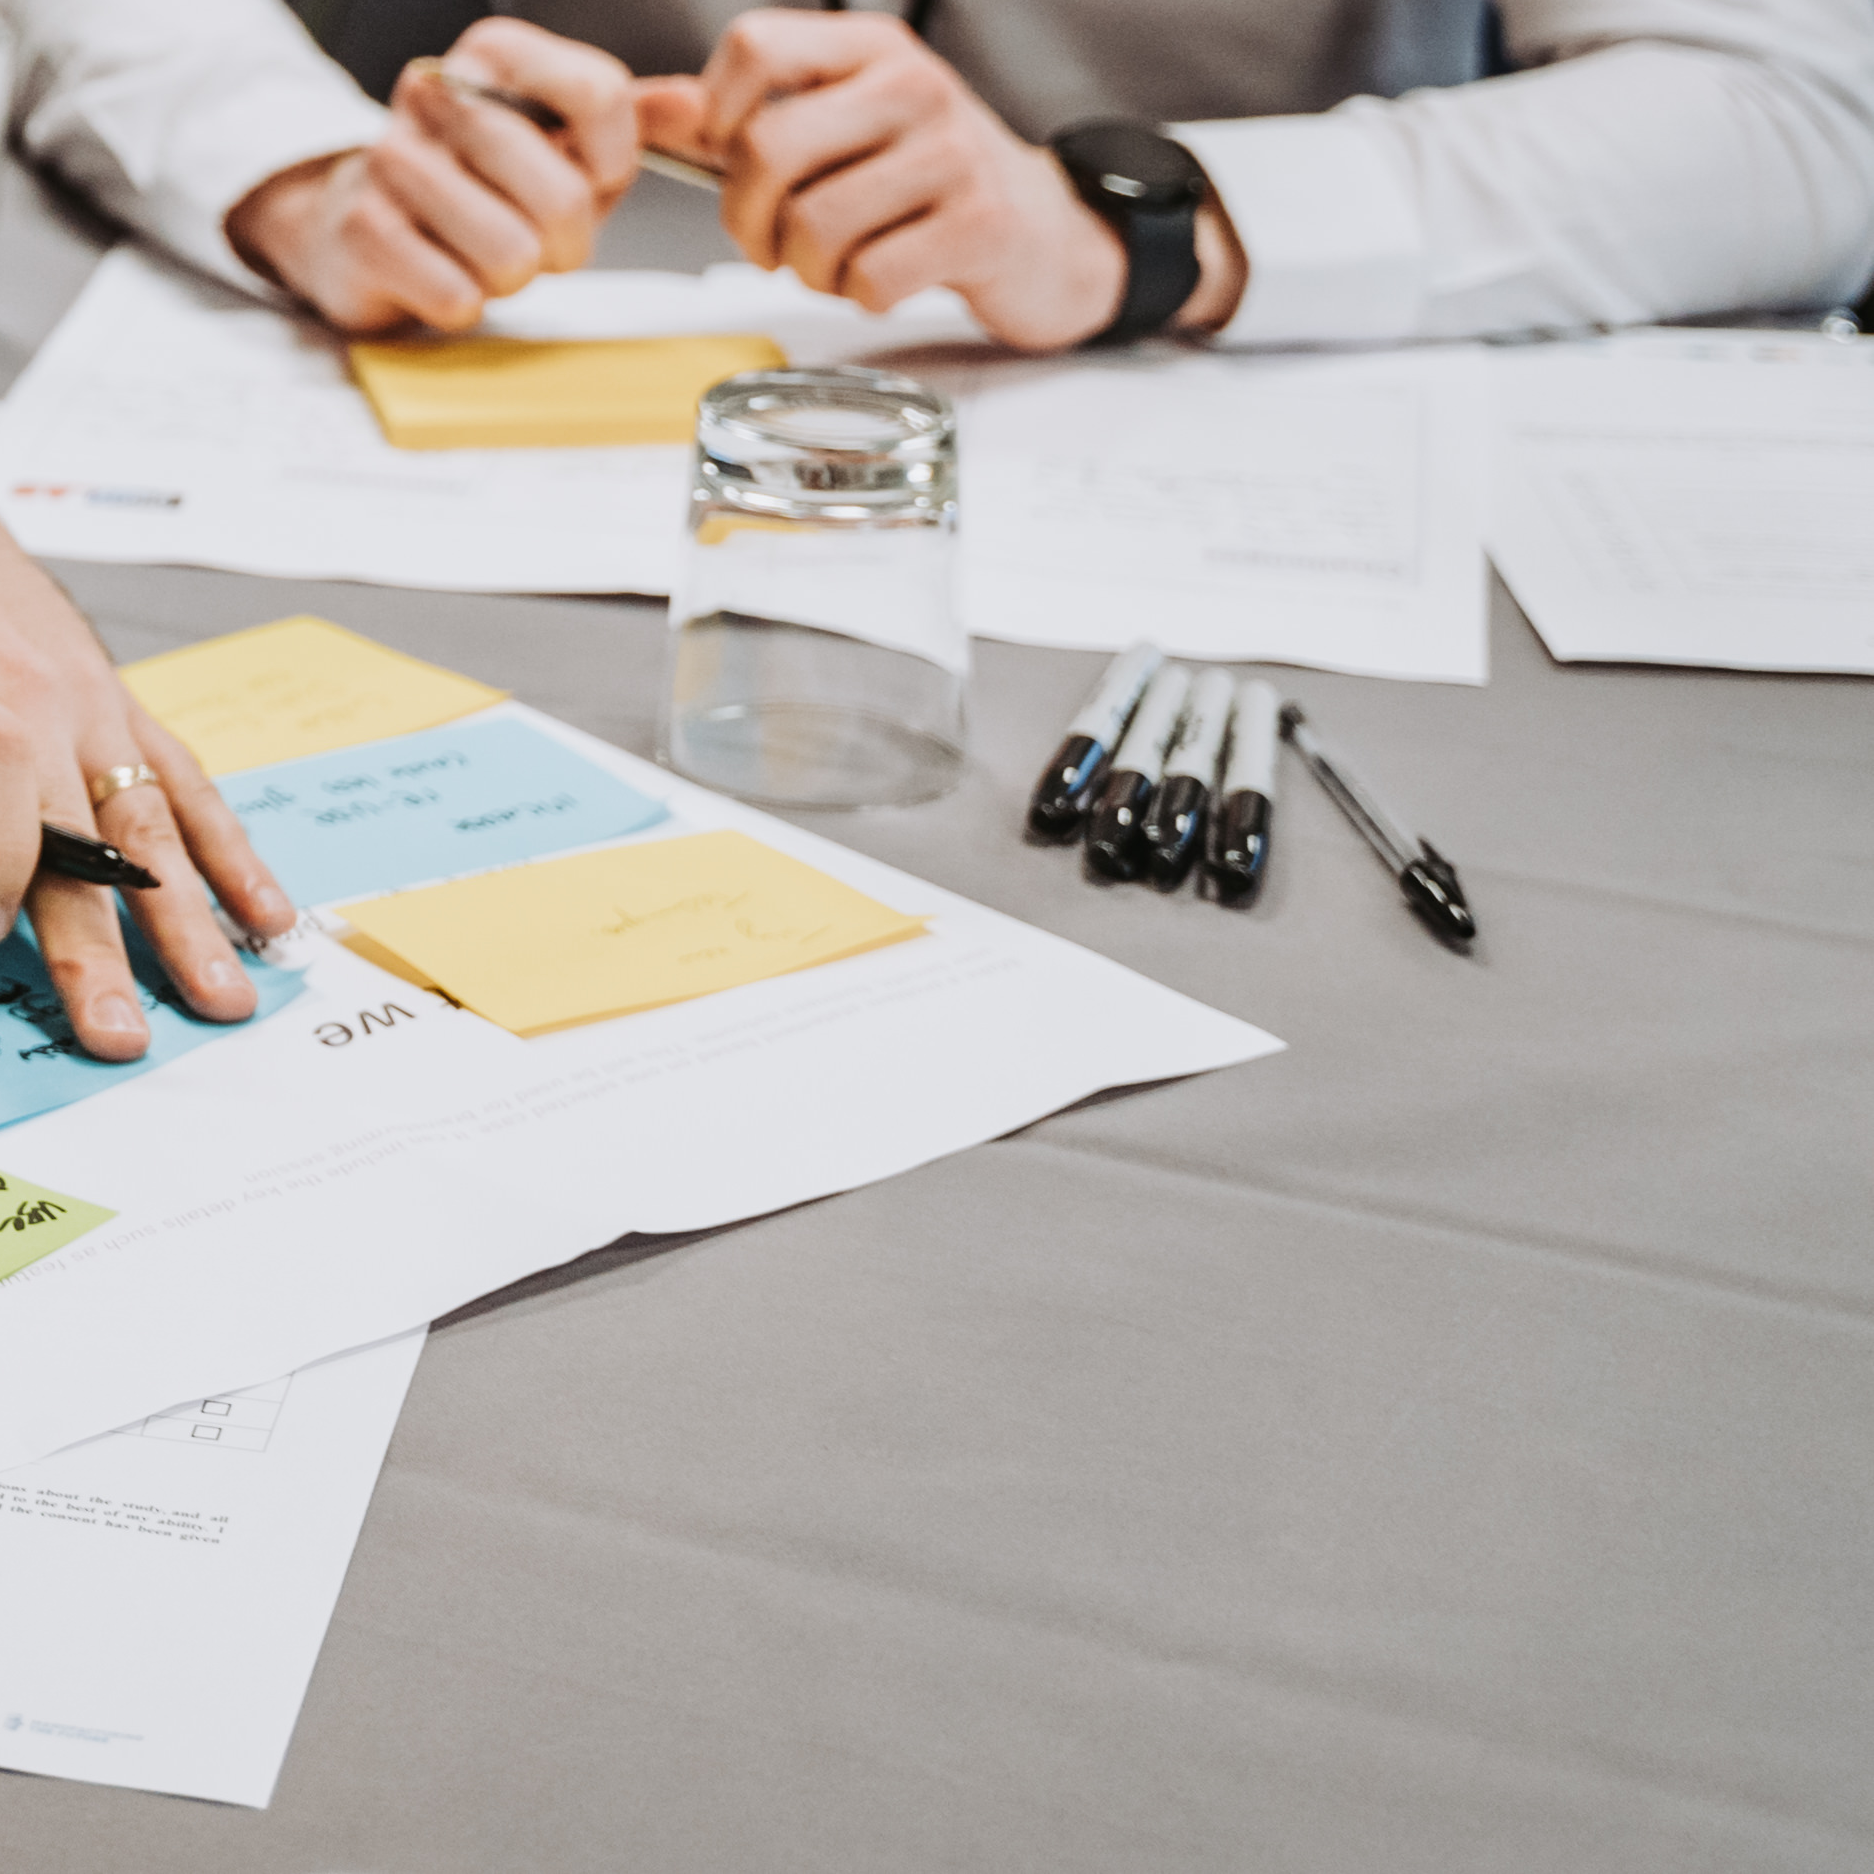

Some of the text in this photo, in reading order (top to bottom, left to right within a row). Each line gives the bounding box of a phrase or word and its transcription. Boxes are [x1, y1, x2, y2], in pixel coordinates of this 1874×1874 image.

[313, 1002, 415, 1047] we
[161, 1196, 238, 1232] details
[70, 1245, 98, 1265] as
[102, 1223, 157, 1254] such
